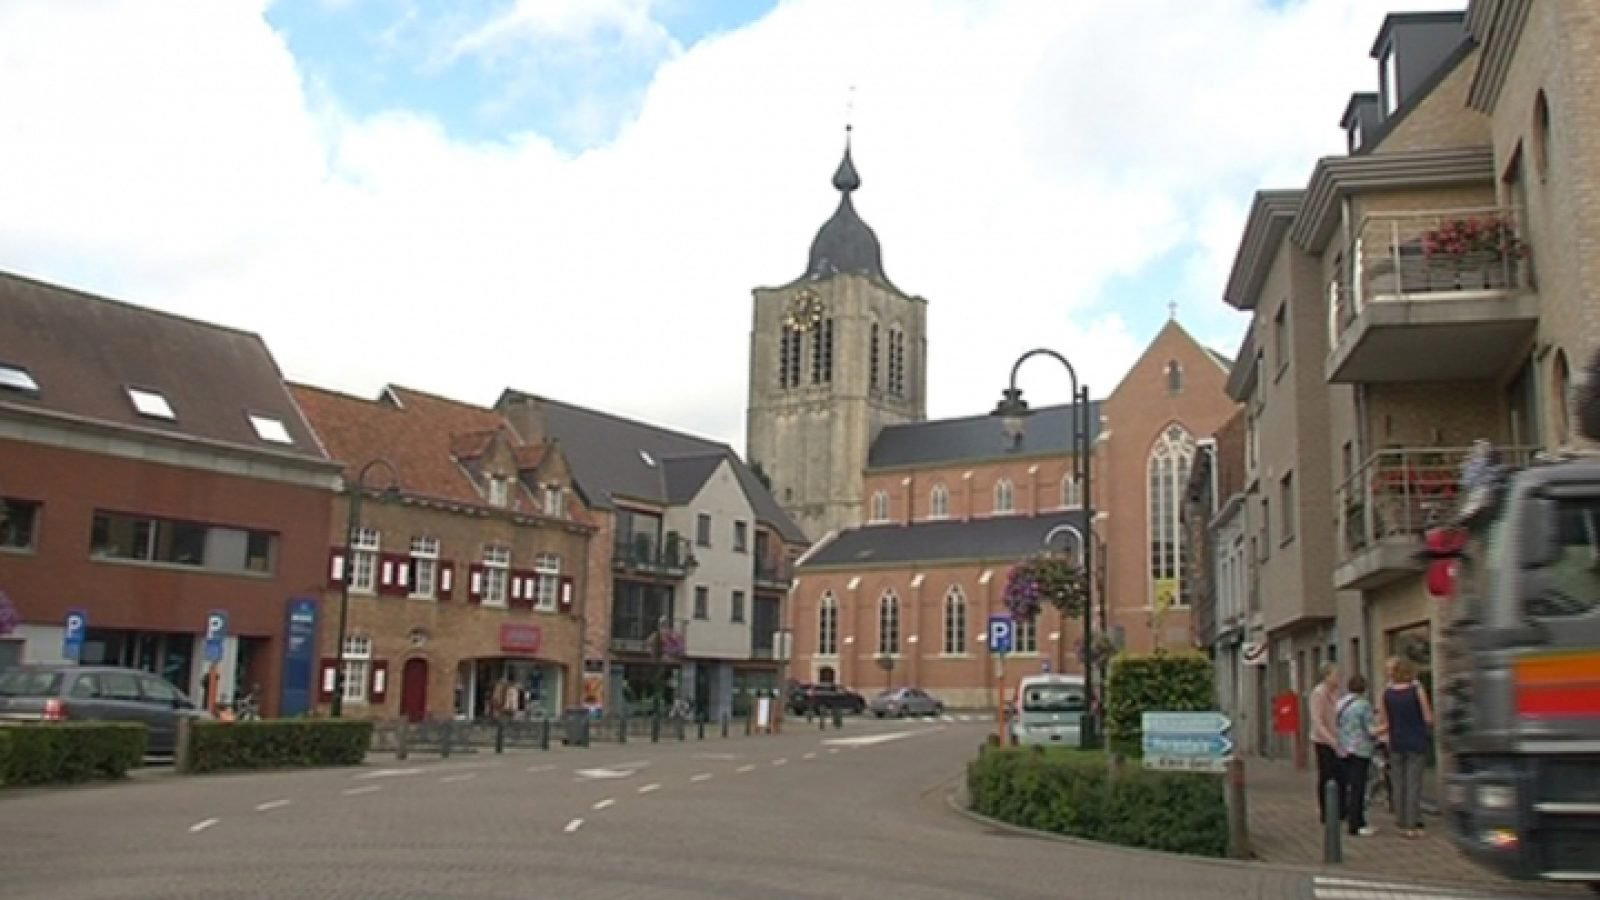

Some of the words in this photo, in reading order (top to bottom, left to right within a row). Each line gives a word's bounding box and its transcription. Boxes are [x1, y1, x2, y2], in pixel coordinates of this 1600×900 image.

[67, 615, 81, 638] P
[208, 615, 223, 638] P
[990, 622, 1008, 647] P
